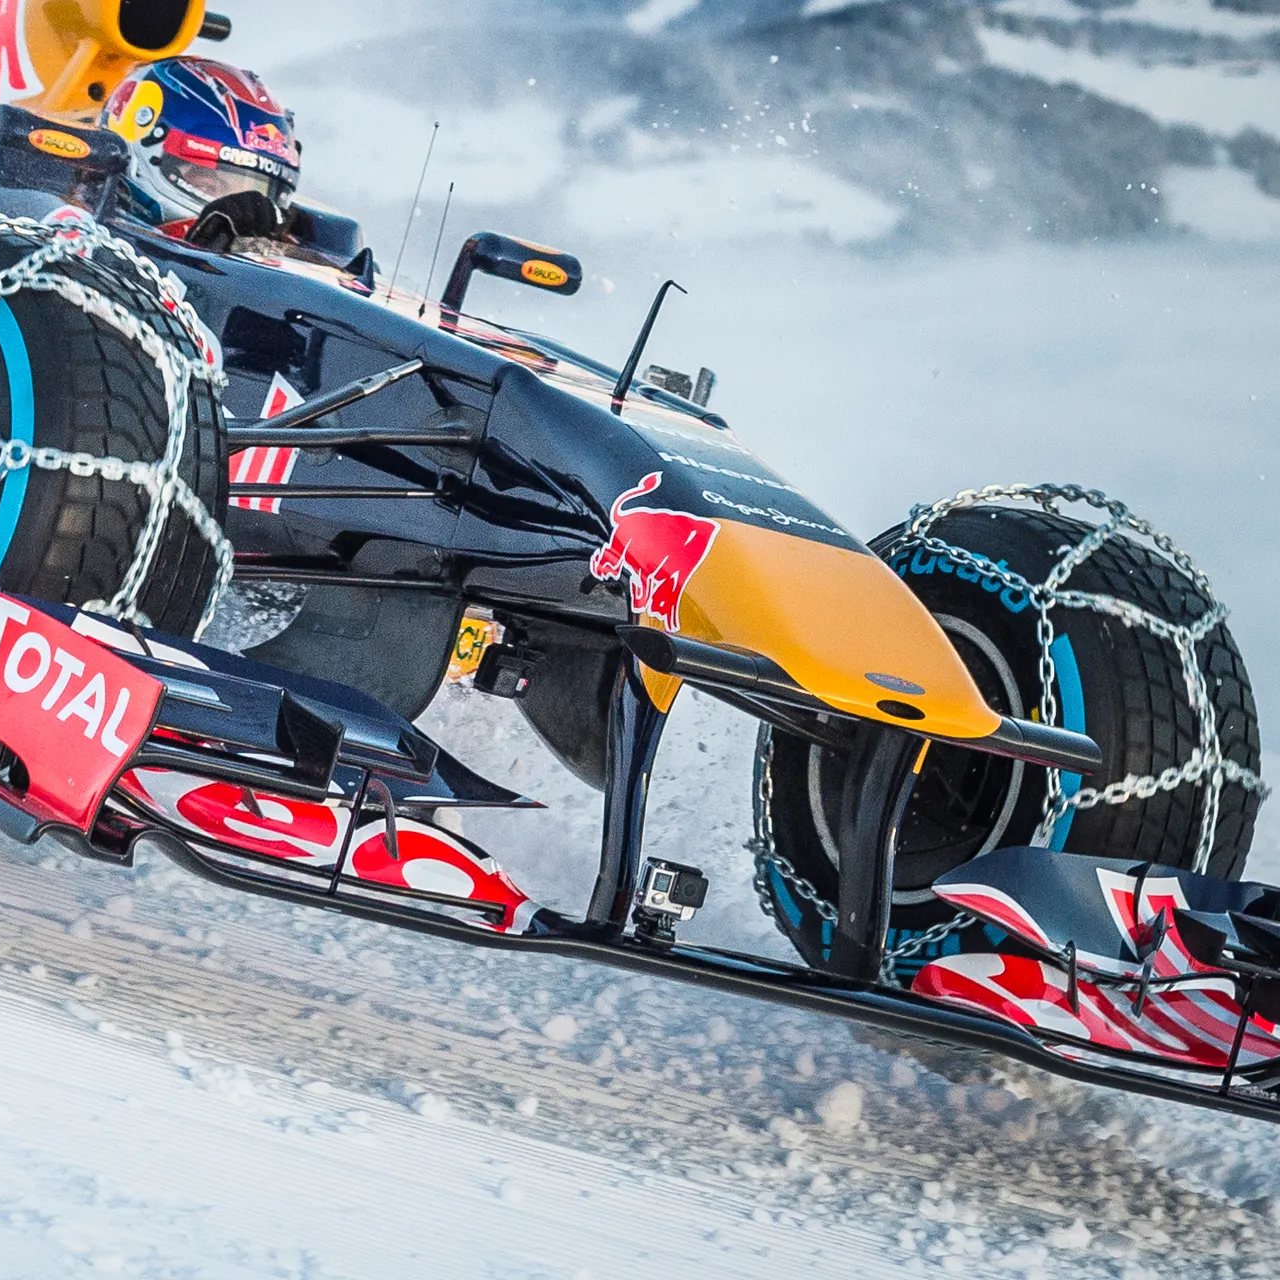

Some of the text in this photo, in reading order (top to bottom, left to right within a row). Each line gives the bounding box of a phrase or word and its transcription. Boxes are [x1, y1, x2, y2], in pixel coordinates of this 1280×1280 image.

[43, 135, 81, 154] RAUCH
[219, 146, 259, 168] GIVES
[701, 490, 770, 517] Pepe
